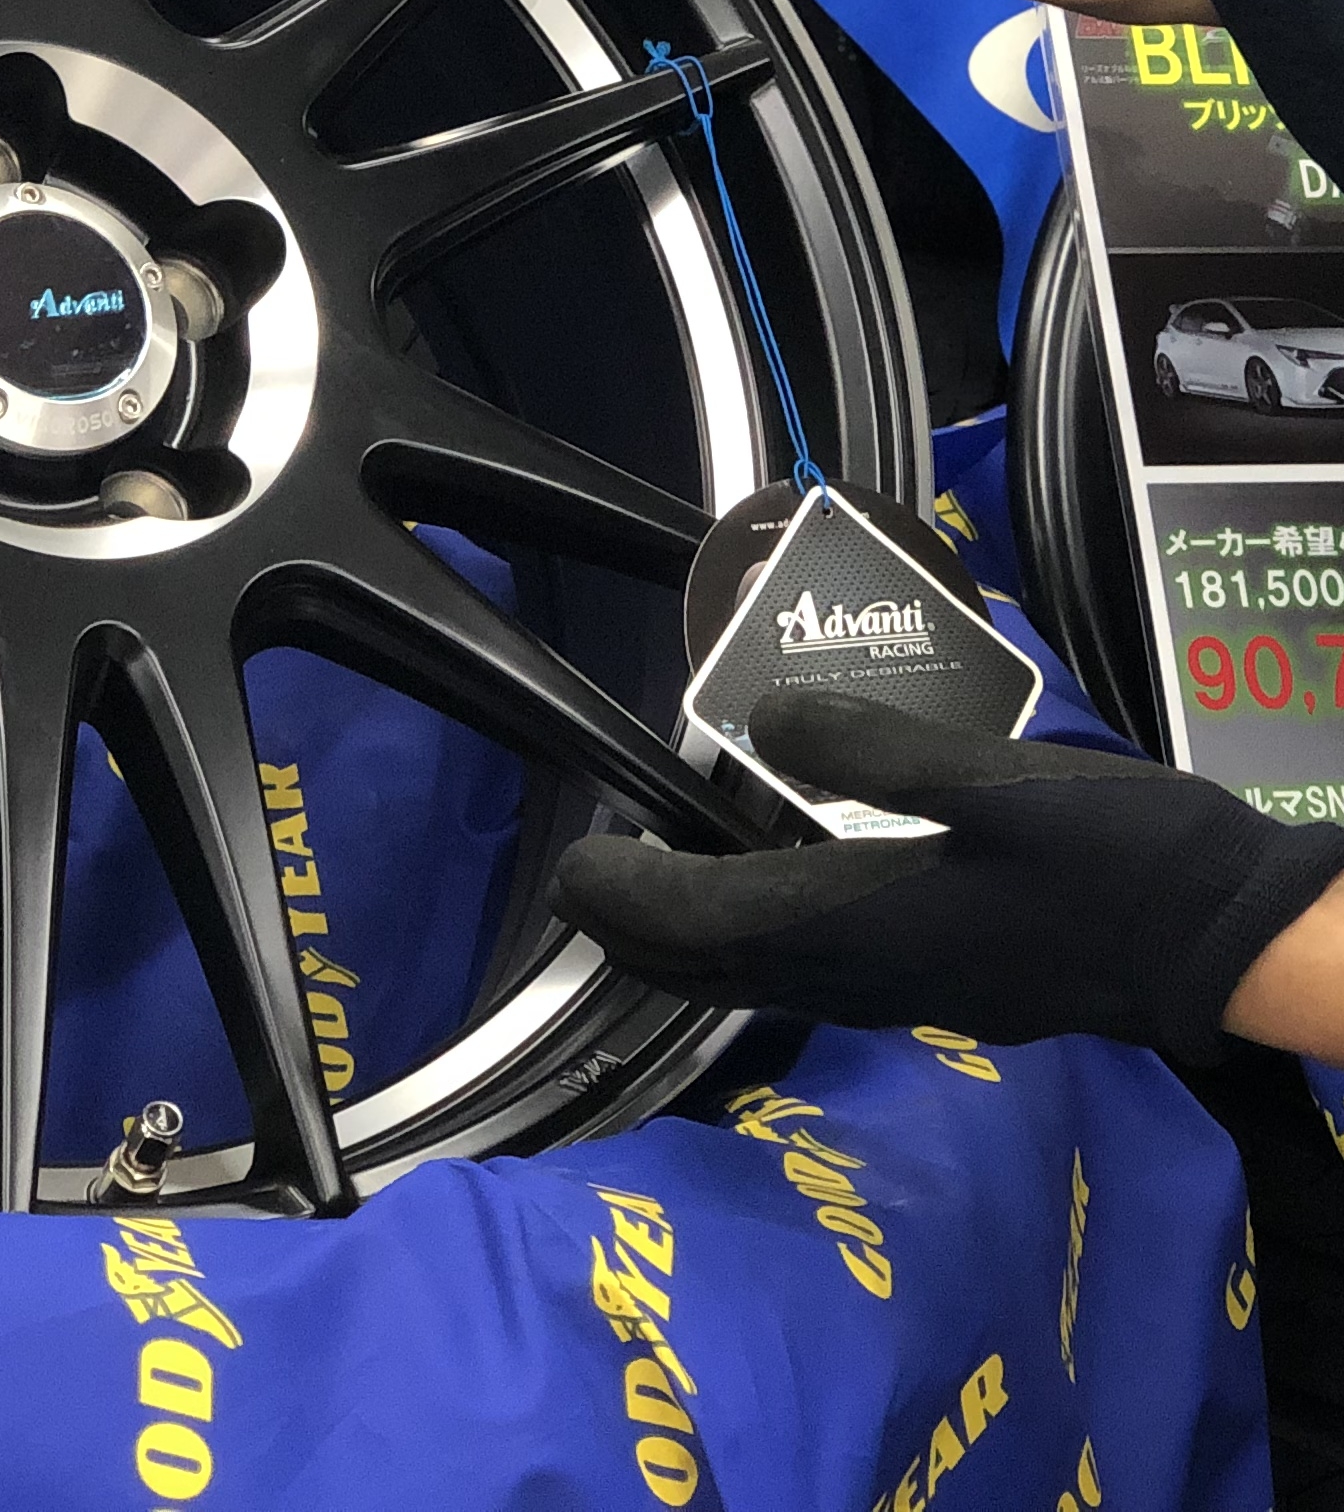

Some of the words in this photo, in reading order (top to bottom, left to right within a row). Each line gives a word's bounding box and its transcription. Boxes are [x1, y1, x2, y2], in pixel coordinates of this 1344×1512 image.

[29, 288, 125, 320] Advanti
[776, 590, 929, 643] Advanti
[868, 641, 936, 660] RACING
